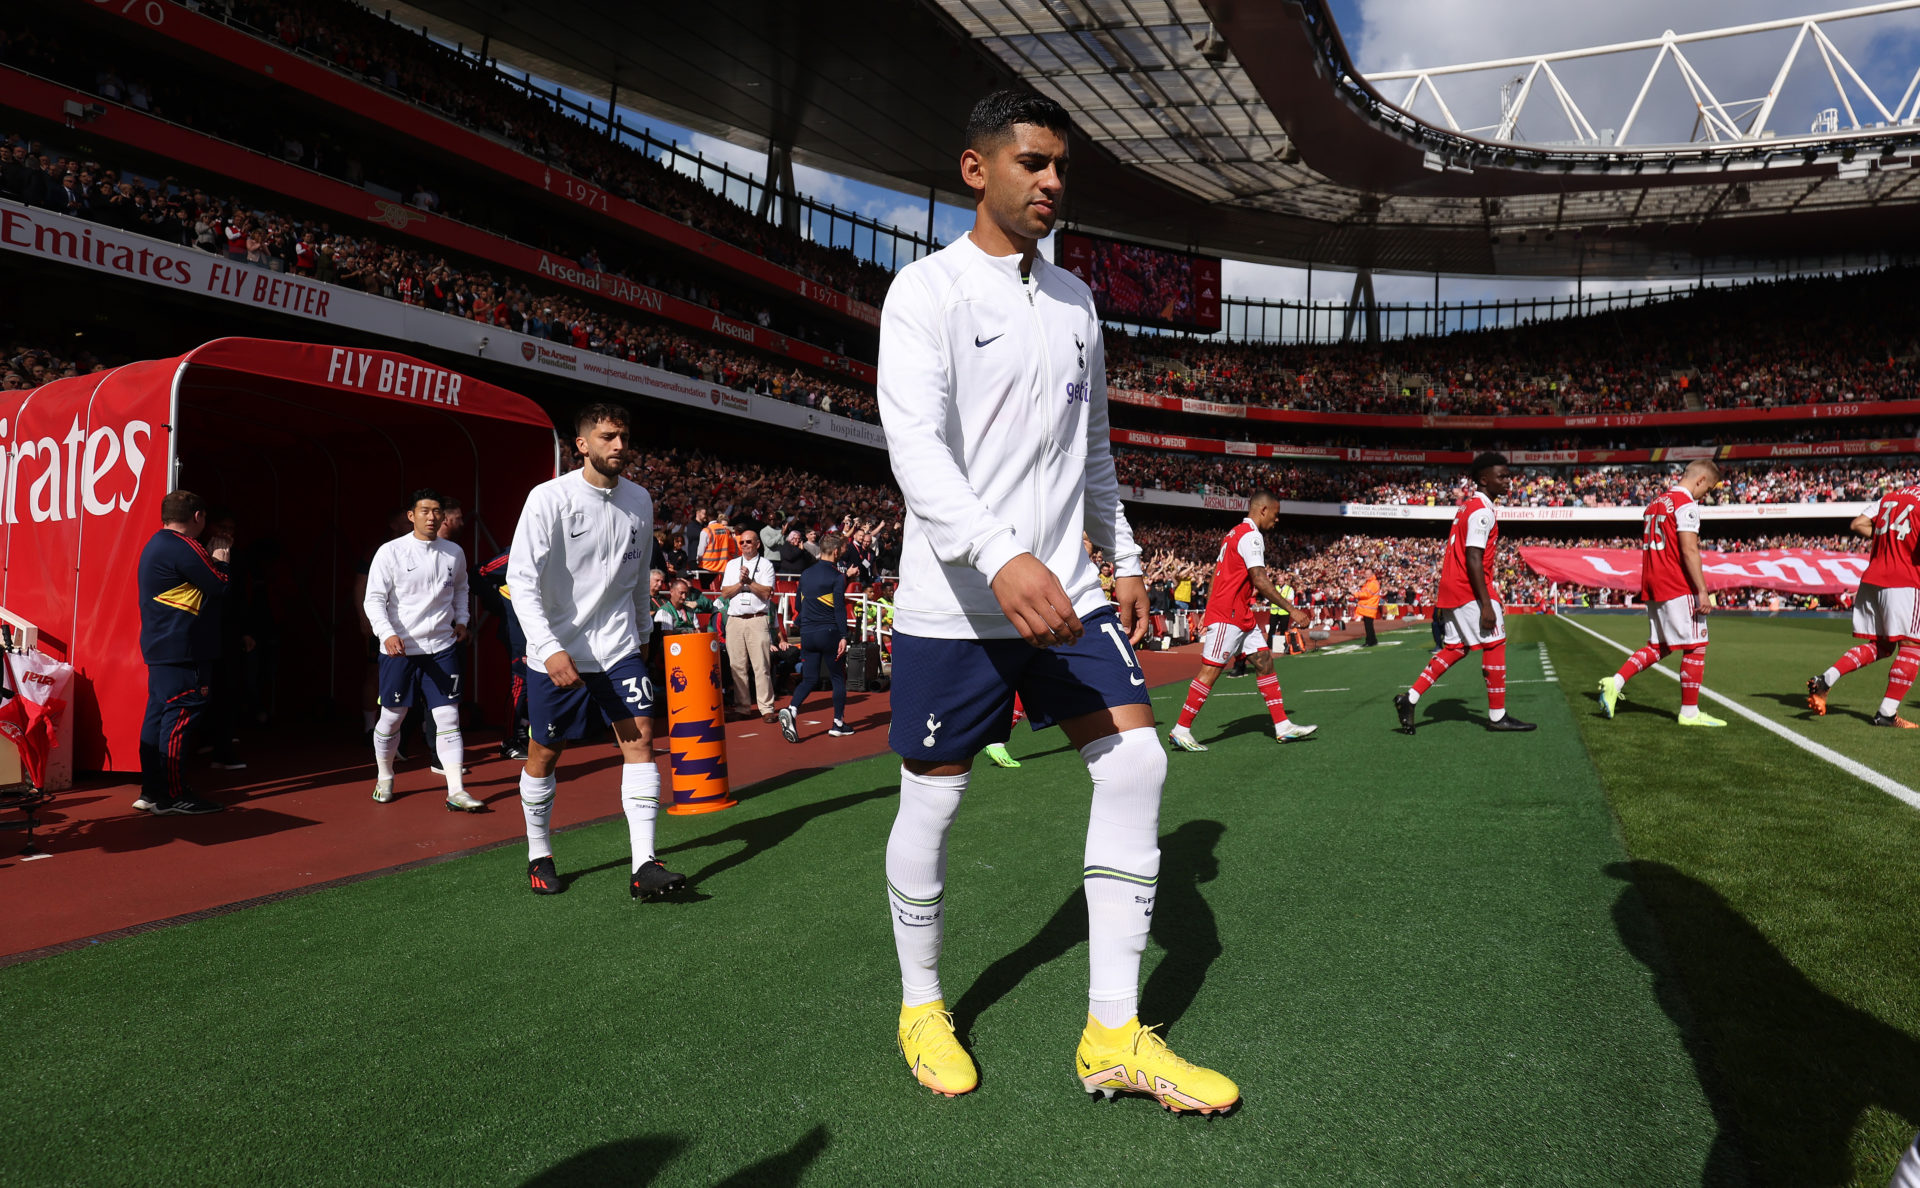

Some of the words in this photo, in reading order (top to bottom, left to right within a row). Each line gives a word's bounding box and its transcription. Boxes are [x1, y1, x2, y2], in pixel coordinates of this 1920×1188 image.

[565, 179, 609, 213] 1971
[1, 208, 192, 286] Emirates
[207, 262, 249, 298] FLY
[253, 273, 331, 318] BETTER
[538, 254, 600, 292] Arsenal
[608, 279, 663, 313] JAPAN
[813, 286, 838, 308] 1971
[712, 314, 755, 343] Arsenal
[537, 345, 551, 358] The
[551, 348, 577, 364] Arsenal
[537, 355, 577, 372] Foundation
[327, 347, 372, 389] FLY
[378, 358, 462, 407] BETTER
[583, 362, 707, 400] www.arsenal.com/thearsenalfoundation
[1616, 415, 1643, 425] 1987
[1827, 405, 1859, 416] 1989
[1129, 432, 1152, 445] ARSENAL
[1161, 436, 1186, 448] SWEDEN
[1771, 444, 1840, 456] Arsenal.com
[1393, 451, 1425, 462] Arsenal
[1495, 509, 1535, 519] Emirates
[1875, 500, 1915, 541] 34
[1643, 514, 1667, 551] 35
[450, 674, 460, 693] 7
[621, 676, 654, 704] 30
